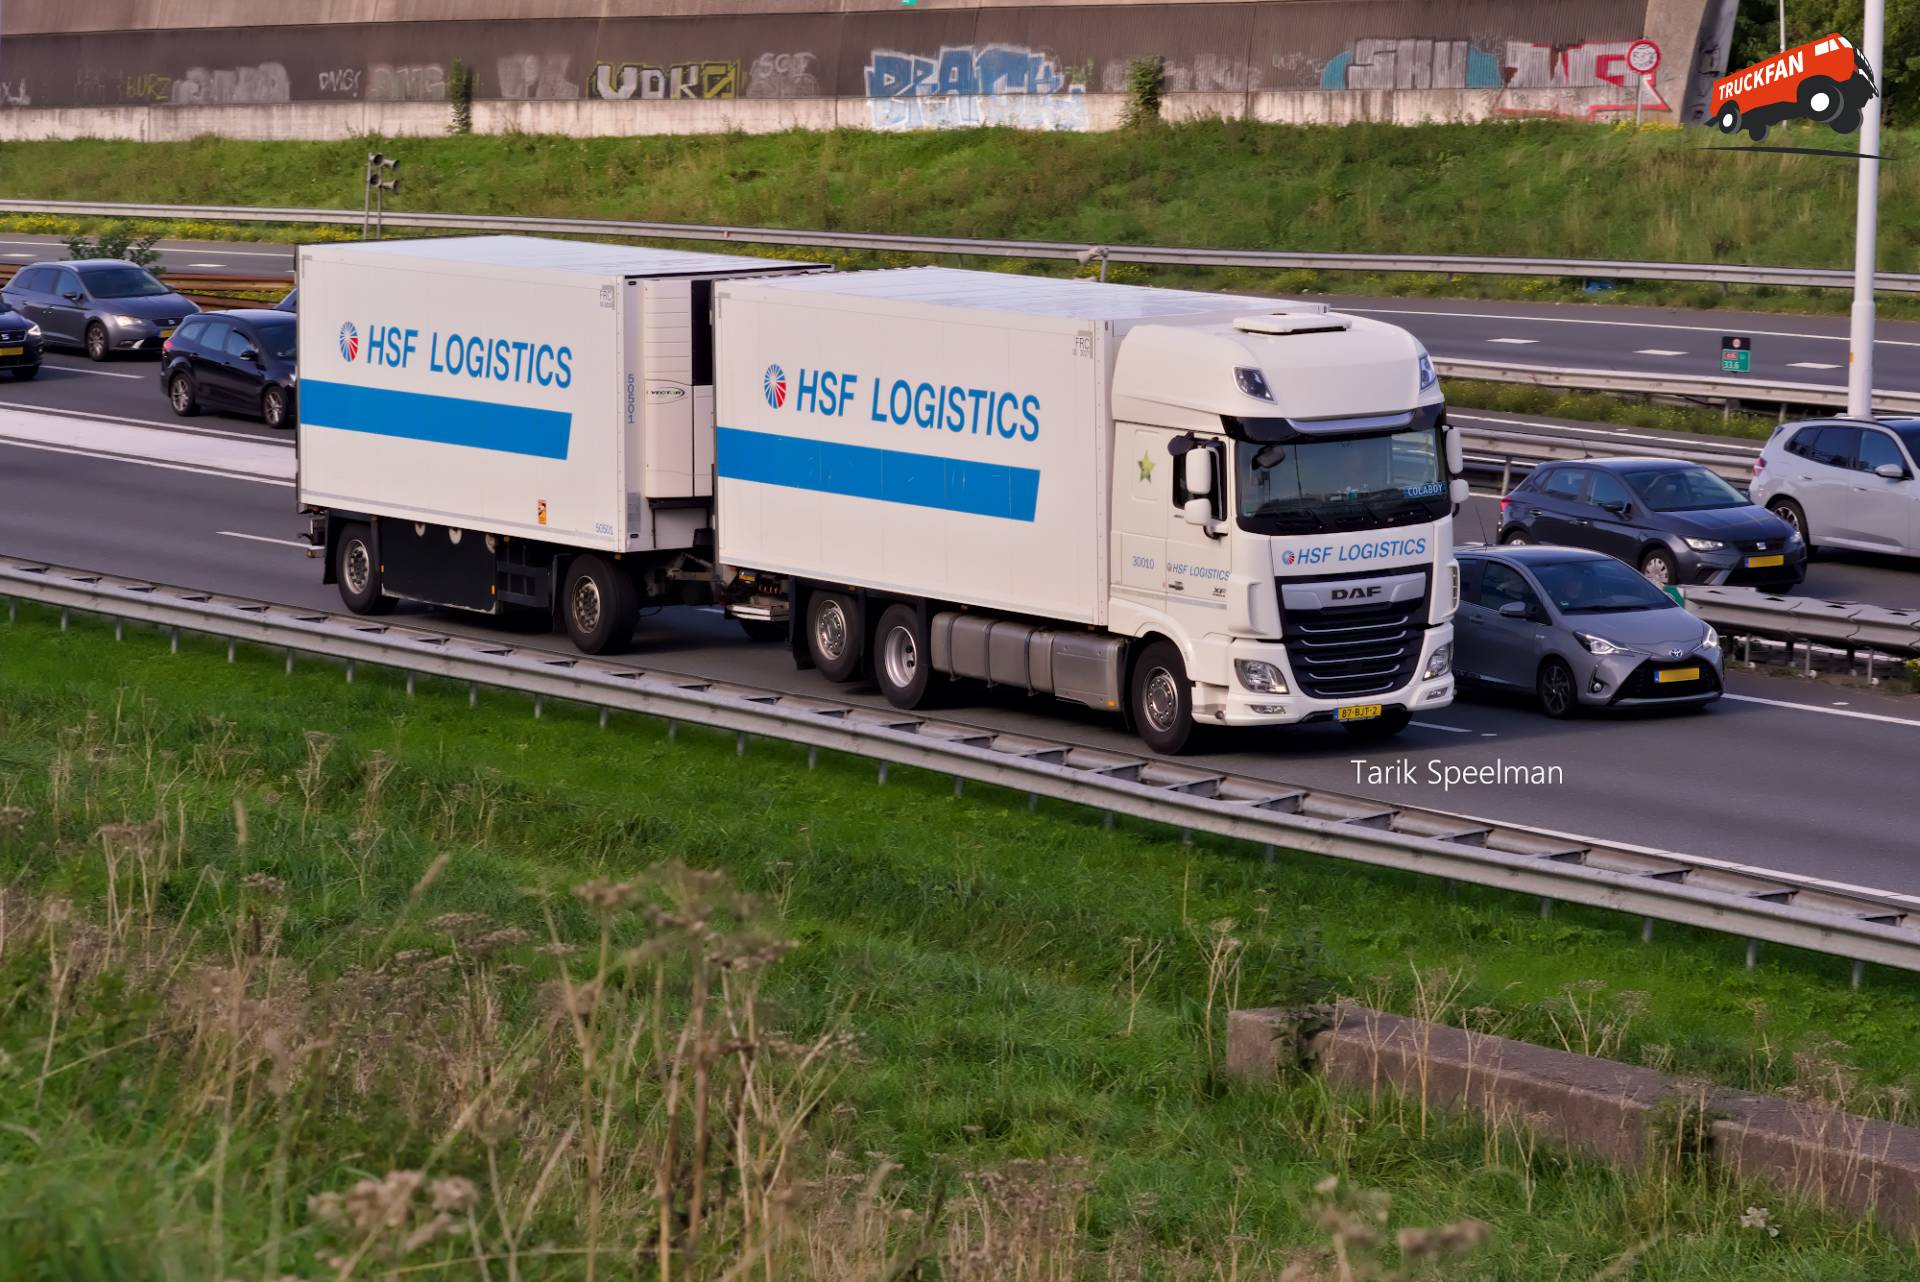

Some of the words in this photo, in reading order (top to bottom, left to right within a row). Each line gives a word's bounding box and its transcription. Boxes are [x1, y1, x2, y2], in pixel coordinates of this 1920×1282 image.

[367, 325, 418, 368] HSF
[430, 332, 573, 389] LOGISTICS
[627, 374, 636, 424] 50501
[797, 368, 857, 417] HSF
[872, 377, 1040, 442] LOGISTICS
[1408, 484, 1443, 497] COLABOY
[1297, 547, 1333, 564] HSF
[1338, 538, 1426, 561] LOGISTICS
[1132, 555, 1155, 570] 30010
[1173, 563, 1189, 575] HSF
[1190, 565, 1231, 581] LOGISTICS
[1331, 586, 1382, 600] DAF
